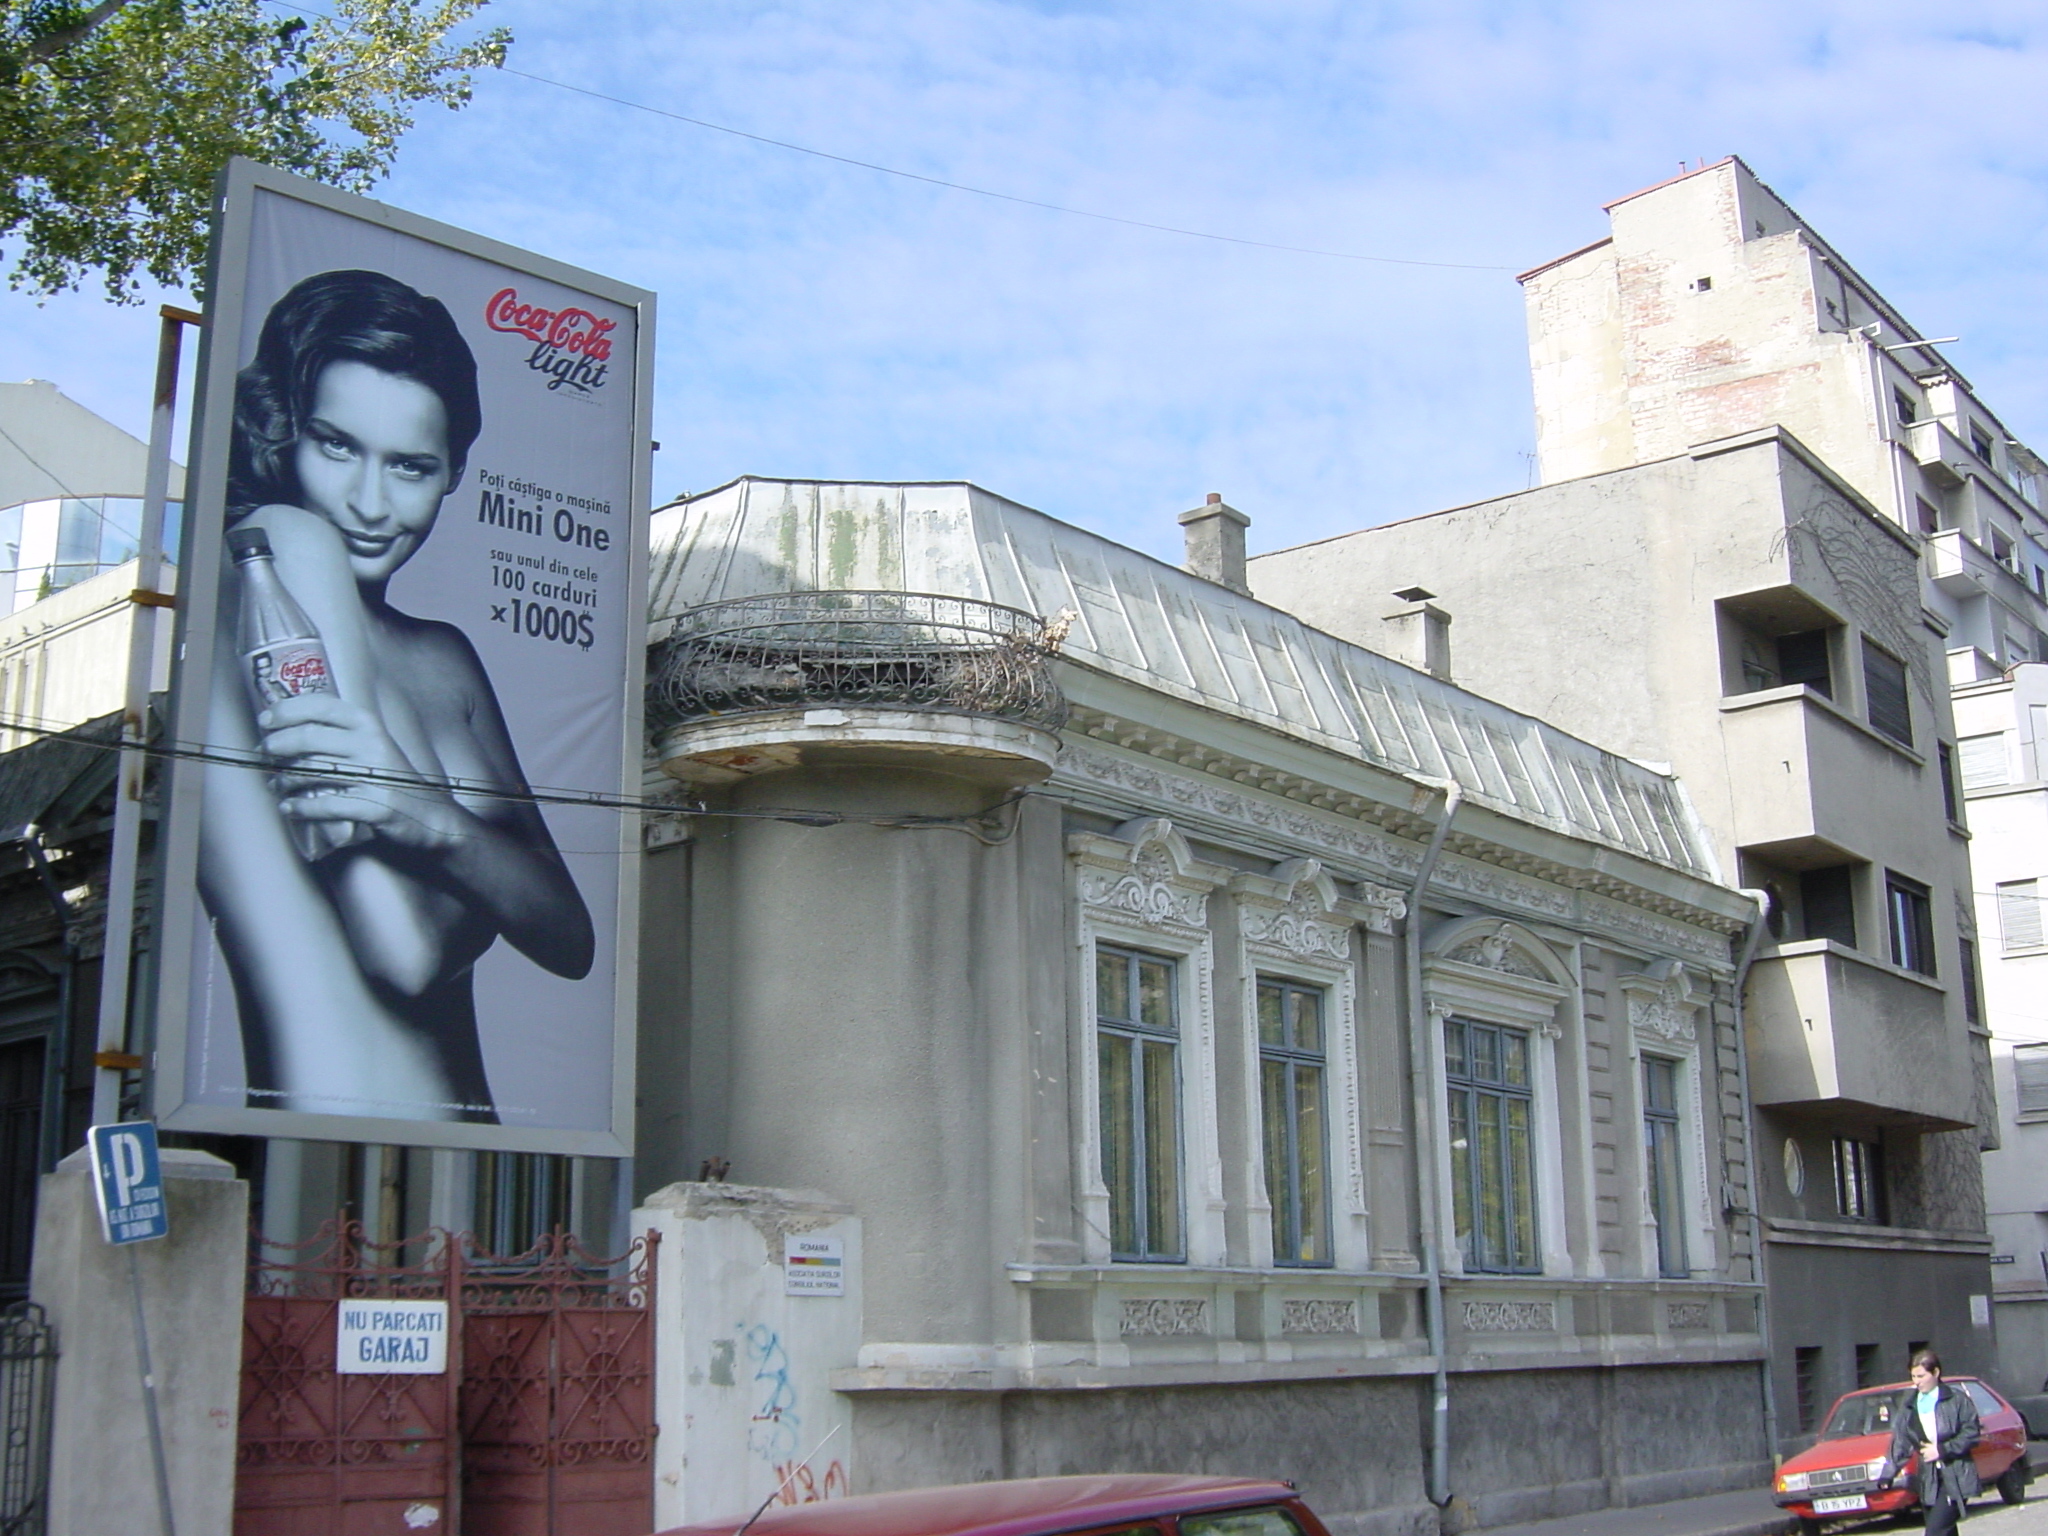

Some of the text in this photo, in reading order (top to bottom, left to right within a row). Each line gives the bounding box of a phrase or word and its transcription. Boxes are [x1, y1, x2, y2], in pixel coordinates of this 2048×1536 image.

[485, 288, 617, 361] Coca-Cola
[524, 340, 609, 391] light
[555, 492, 563, 502] o
[478, 490, 610, 551] Mini One
[490, 549, 598, 582] sau unul din cele
[492, 565, 597, 608] 100 carduri
[280, 658, 325, 681] Coca-Cola
[110, 1132, 144, 1207] P
[344, 1311, 442, 1332] NU PARCATI
[359, 1336, 429, 1363] GARAJ
